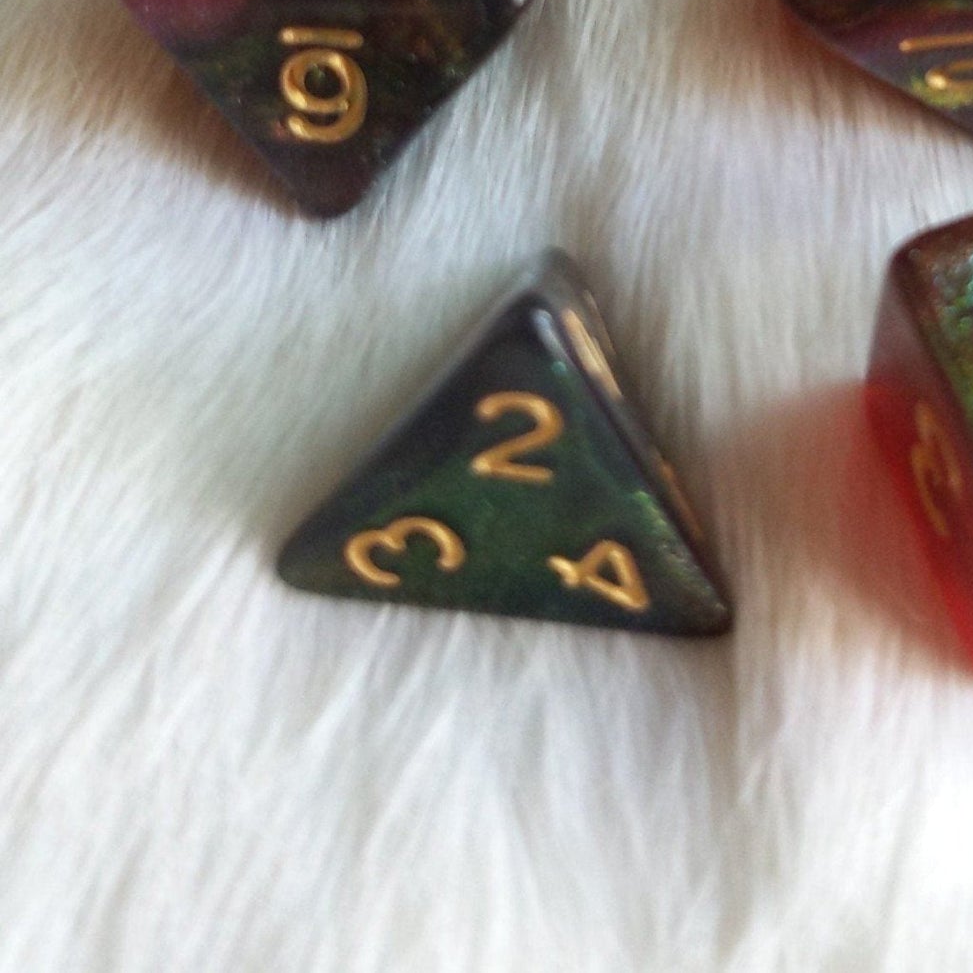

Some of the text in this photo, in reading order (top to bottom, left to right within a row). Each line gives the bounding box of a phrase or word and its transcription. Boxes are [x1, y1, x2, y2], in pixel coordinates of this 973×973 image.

[470, 390, 564, 485] 2
[344, 515, 466, 587] 3
[547, 539, 650, 613] 4
